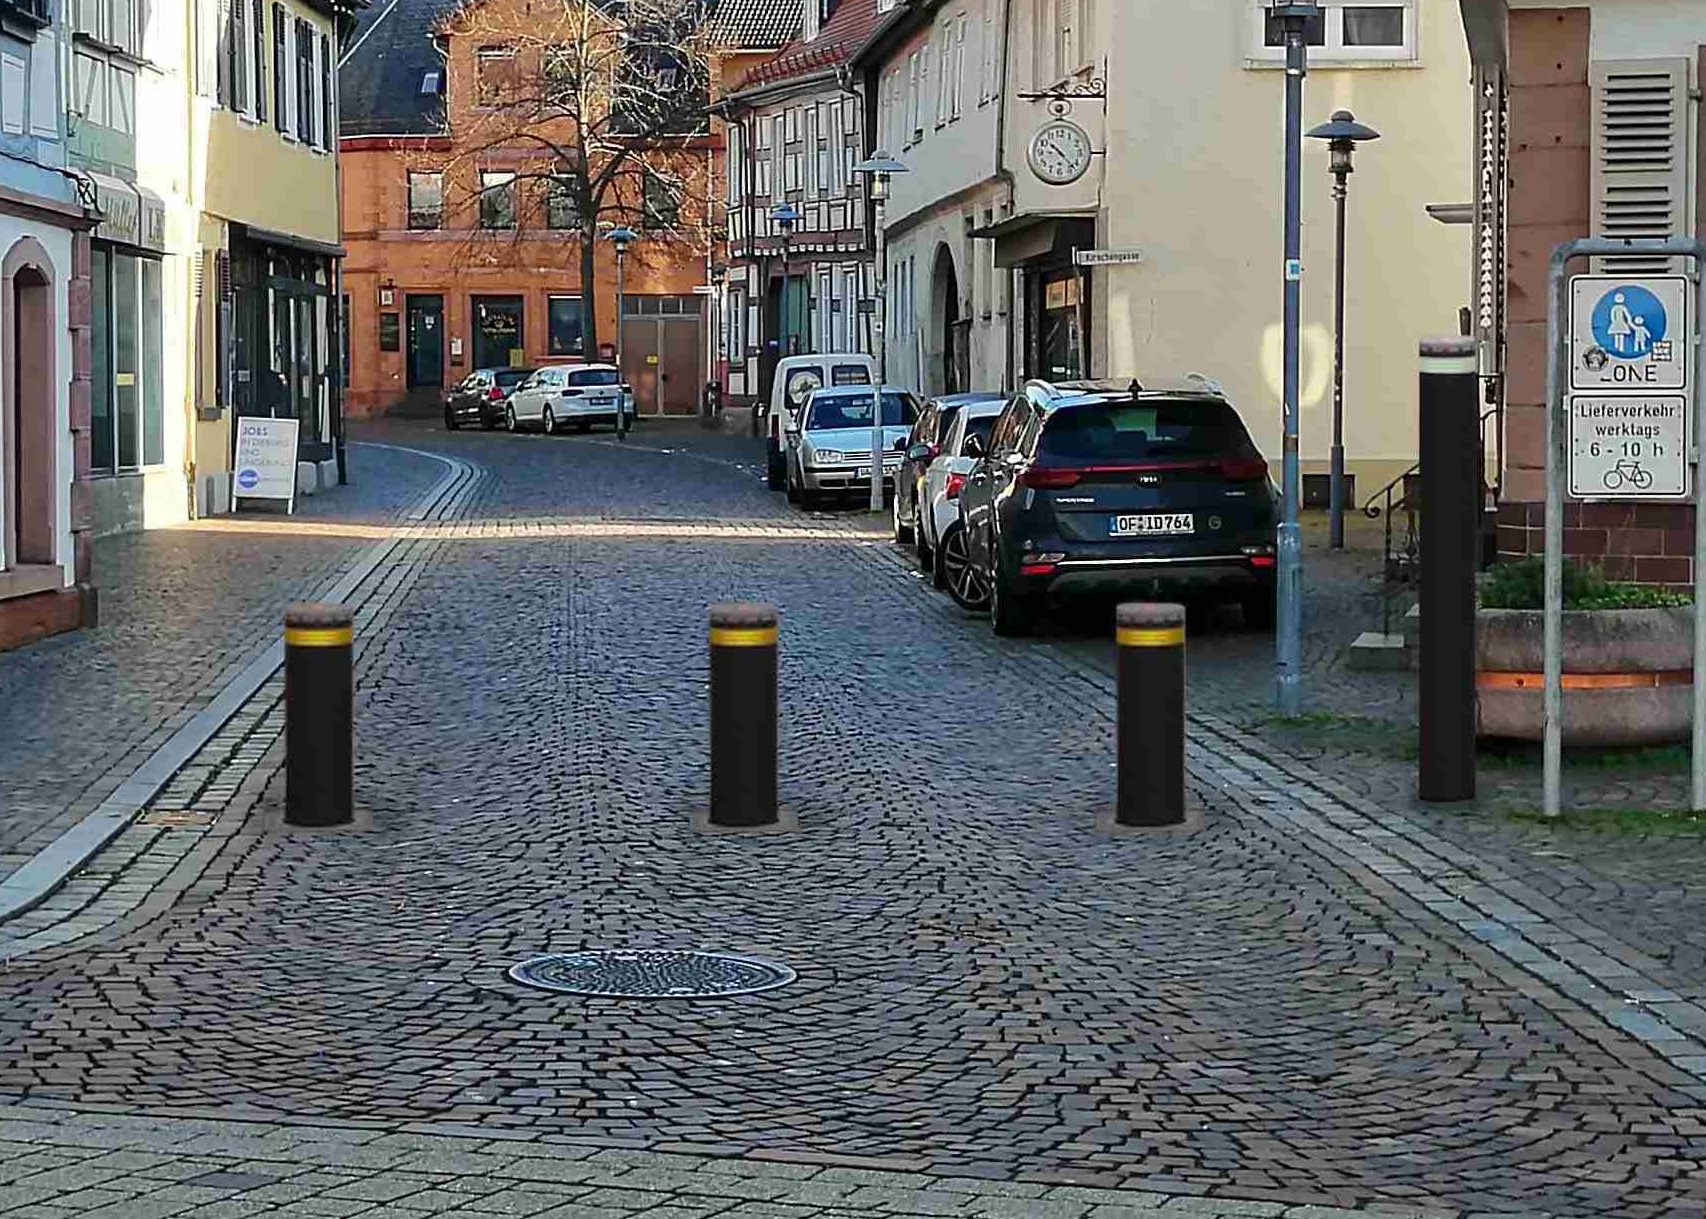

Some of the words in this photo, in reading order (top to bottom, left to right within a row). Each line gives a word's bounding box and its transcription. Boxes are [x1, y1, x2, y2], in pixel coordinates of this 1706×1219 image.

[1600, 364, 1657, 382] ONE
[1580, 403, 1675, 418] Lieferverkehr
[1595, 422, 1660, 439] werktags
[1589, 442, 1601, 457] 6
[1621, 441, 1641, 457] 10
[1653, 442, 1664, 457] h
